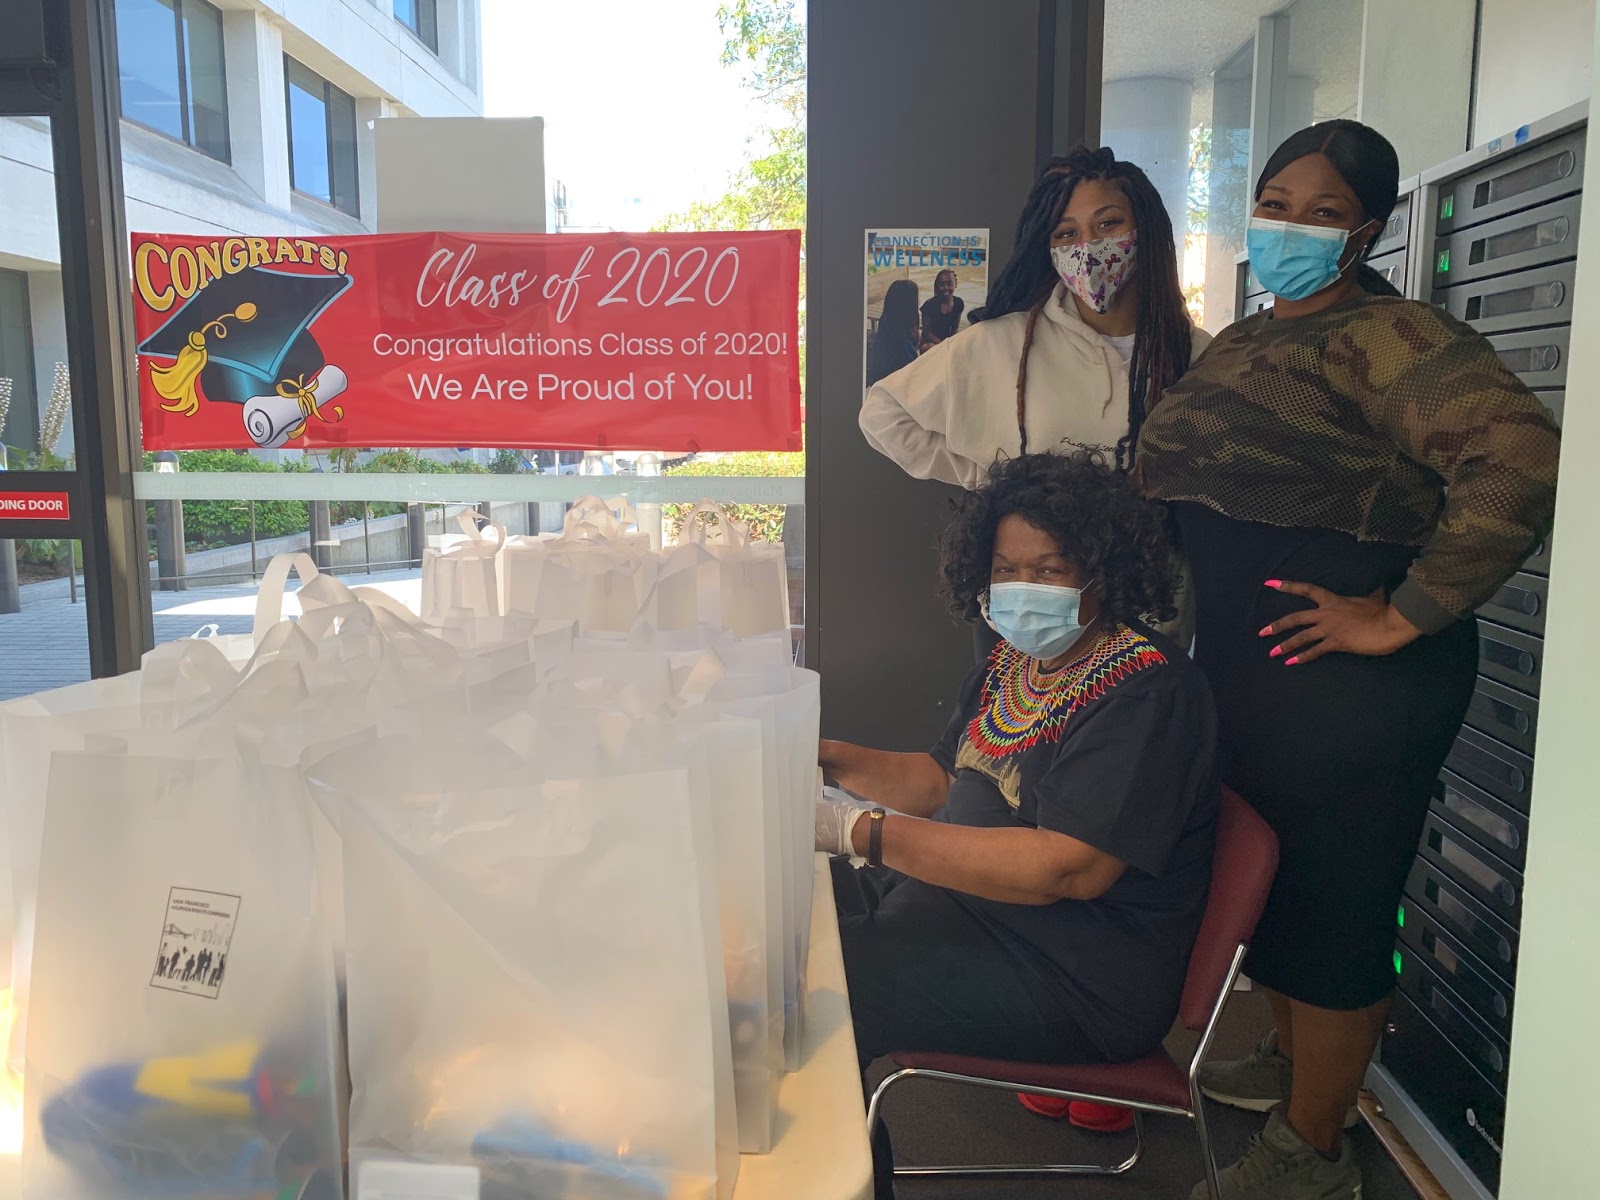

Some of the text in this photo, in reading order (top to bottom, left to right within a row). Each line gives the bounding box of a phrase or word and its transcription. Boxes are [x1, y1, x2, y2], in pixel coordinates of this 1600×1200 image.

[873, 236, 977, 247] CONNECTION IS
[872, 249, 983, 267] WELLNESS
[134, 237, 348, 312] CONGRATS!
[416, 243, 739, 323] Class of 2020
[373, 331, 787, 362] Congratulations Class of 2020!
[407, 372, 753, 401] We Are Proud of You!
[28, 499, 63, 510] DOOR
